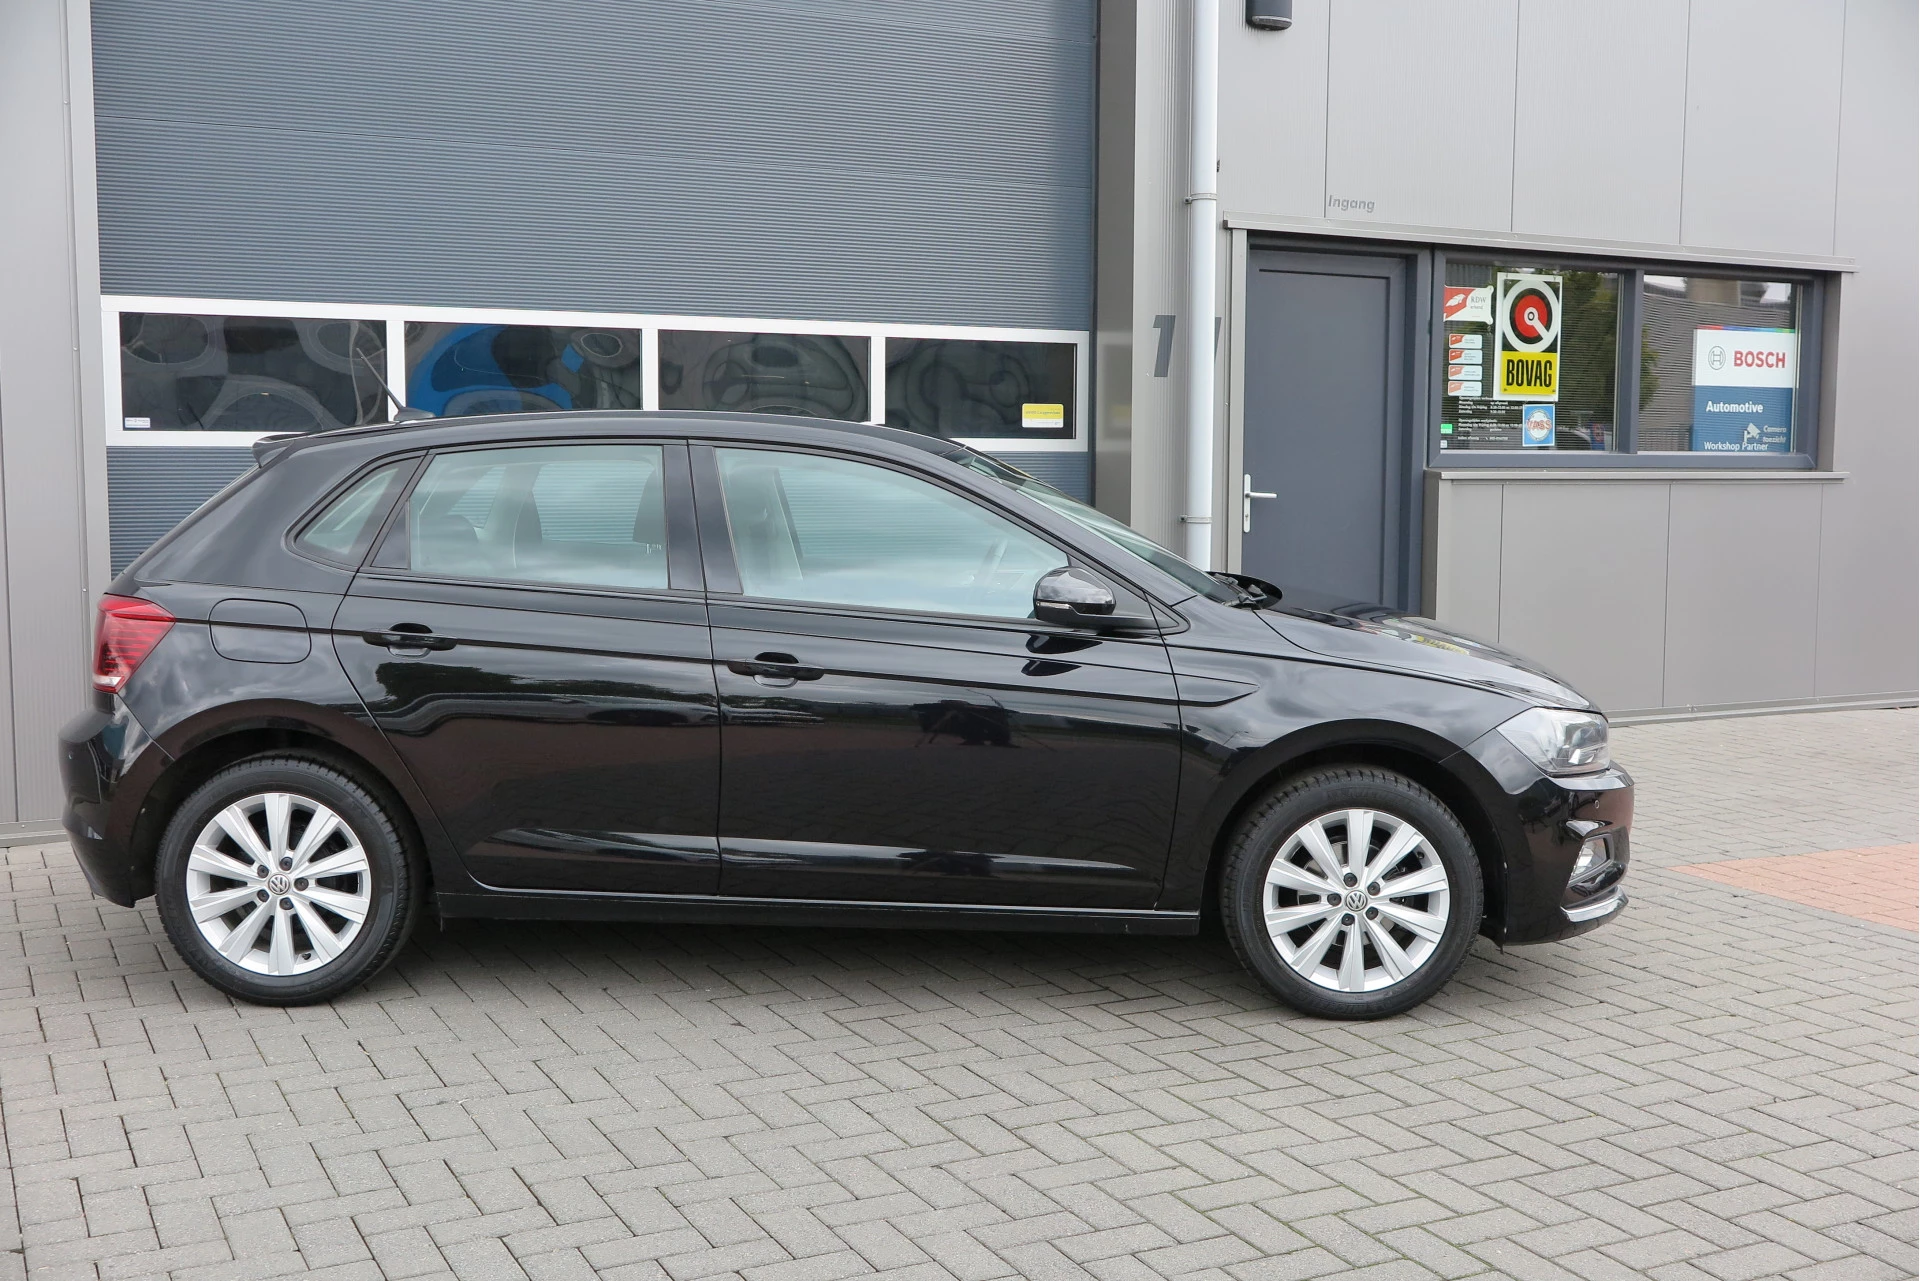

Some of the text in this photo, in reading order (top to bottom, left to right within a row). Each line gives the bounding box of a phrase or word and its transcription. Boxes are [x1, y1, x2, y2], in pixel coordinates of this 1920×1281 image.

[1328, 195, 1375, 213] Ingang
[1733, 350, 1786, 368] BOSCH
[1506, 359, 1553, 388] BOVAG
[1705, 401, 1764, 413] Automotive
[1704, 441, 1769, 451] Workshop Partner
